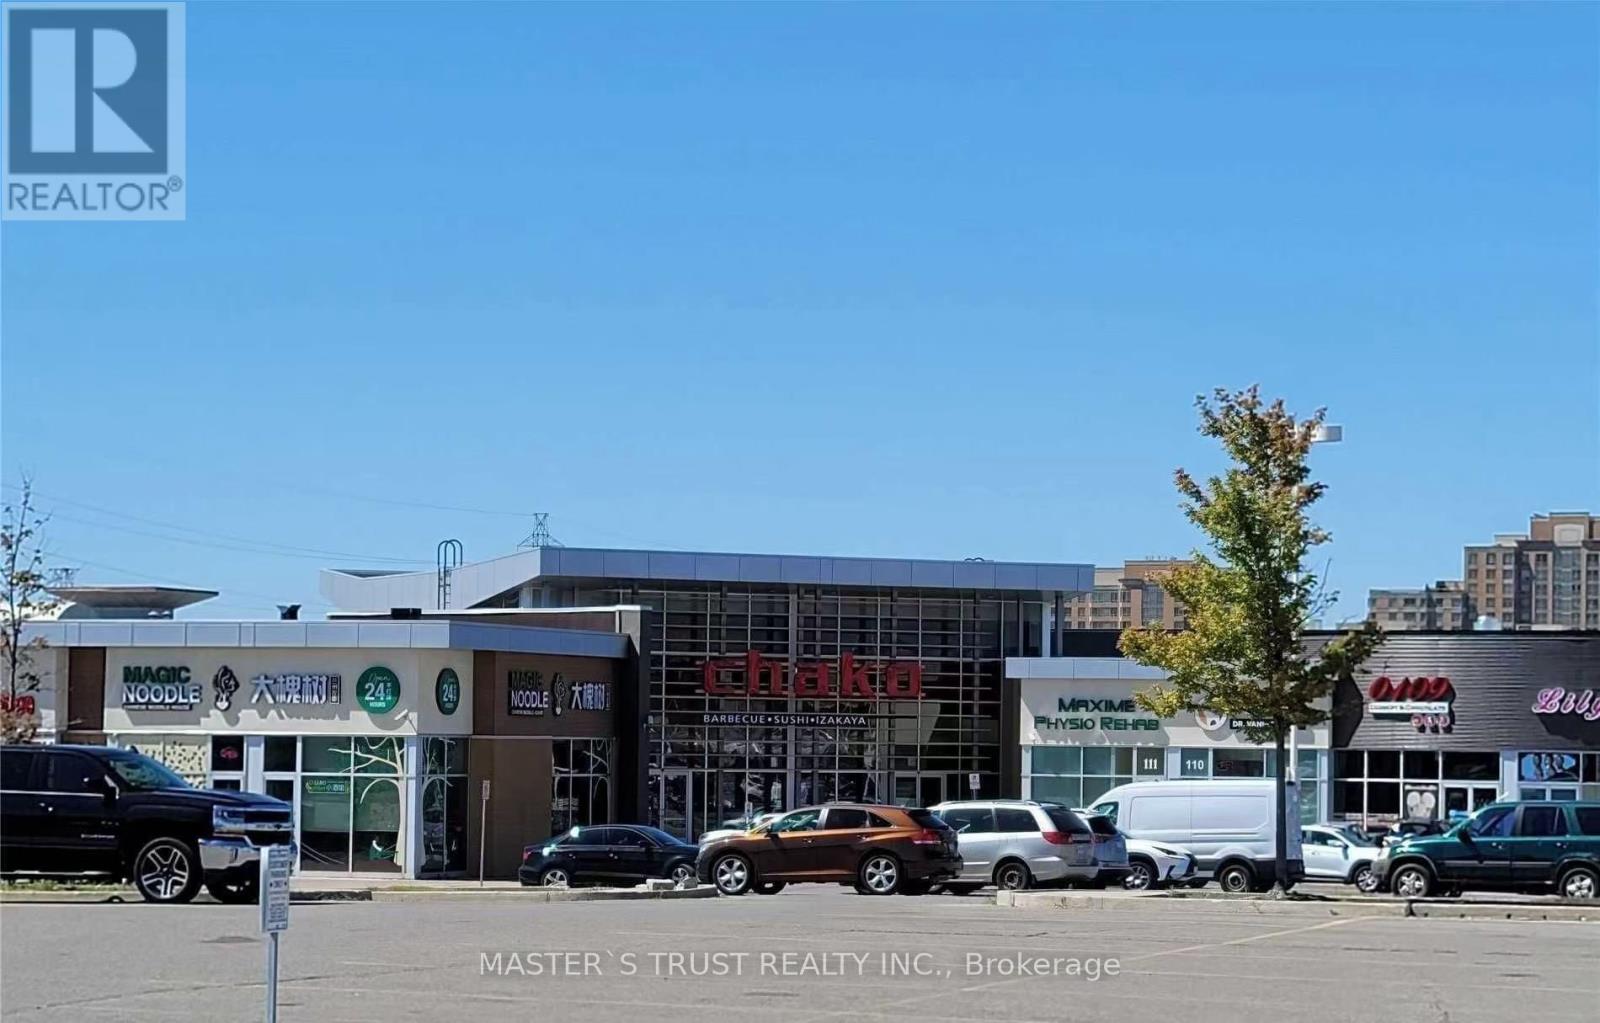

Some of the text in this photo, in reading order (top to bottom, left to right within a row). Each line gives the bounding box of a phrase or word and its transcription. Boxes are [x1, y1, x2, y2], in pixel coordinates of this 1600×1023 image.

[122, 666, 191, 683] MAGIC
[703, 650, 922, 699] chako
[122, 685, 203, 703] NOODLE
[364, 682, 386, 701] 24
[442, 683, 454, 702] 24
[511, 690, 549, 708] NOODLE
[1058, 698, 1136, 713] MAXIME
[703, 714, 867, 726] BARBECUE SUSHI IZAKAYA
[1034, 716, 1160, 731] PHYSIO REHAB
[1232, 720, 1245, 728] DR.
[1143, 758, 1158, 770] 111
[1186, 760, 1204, 770] 110
